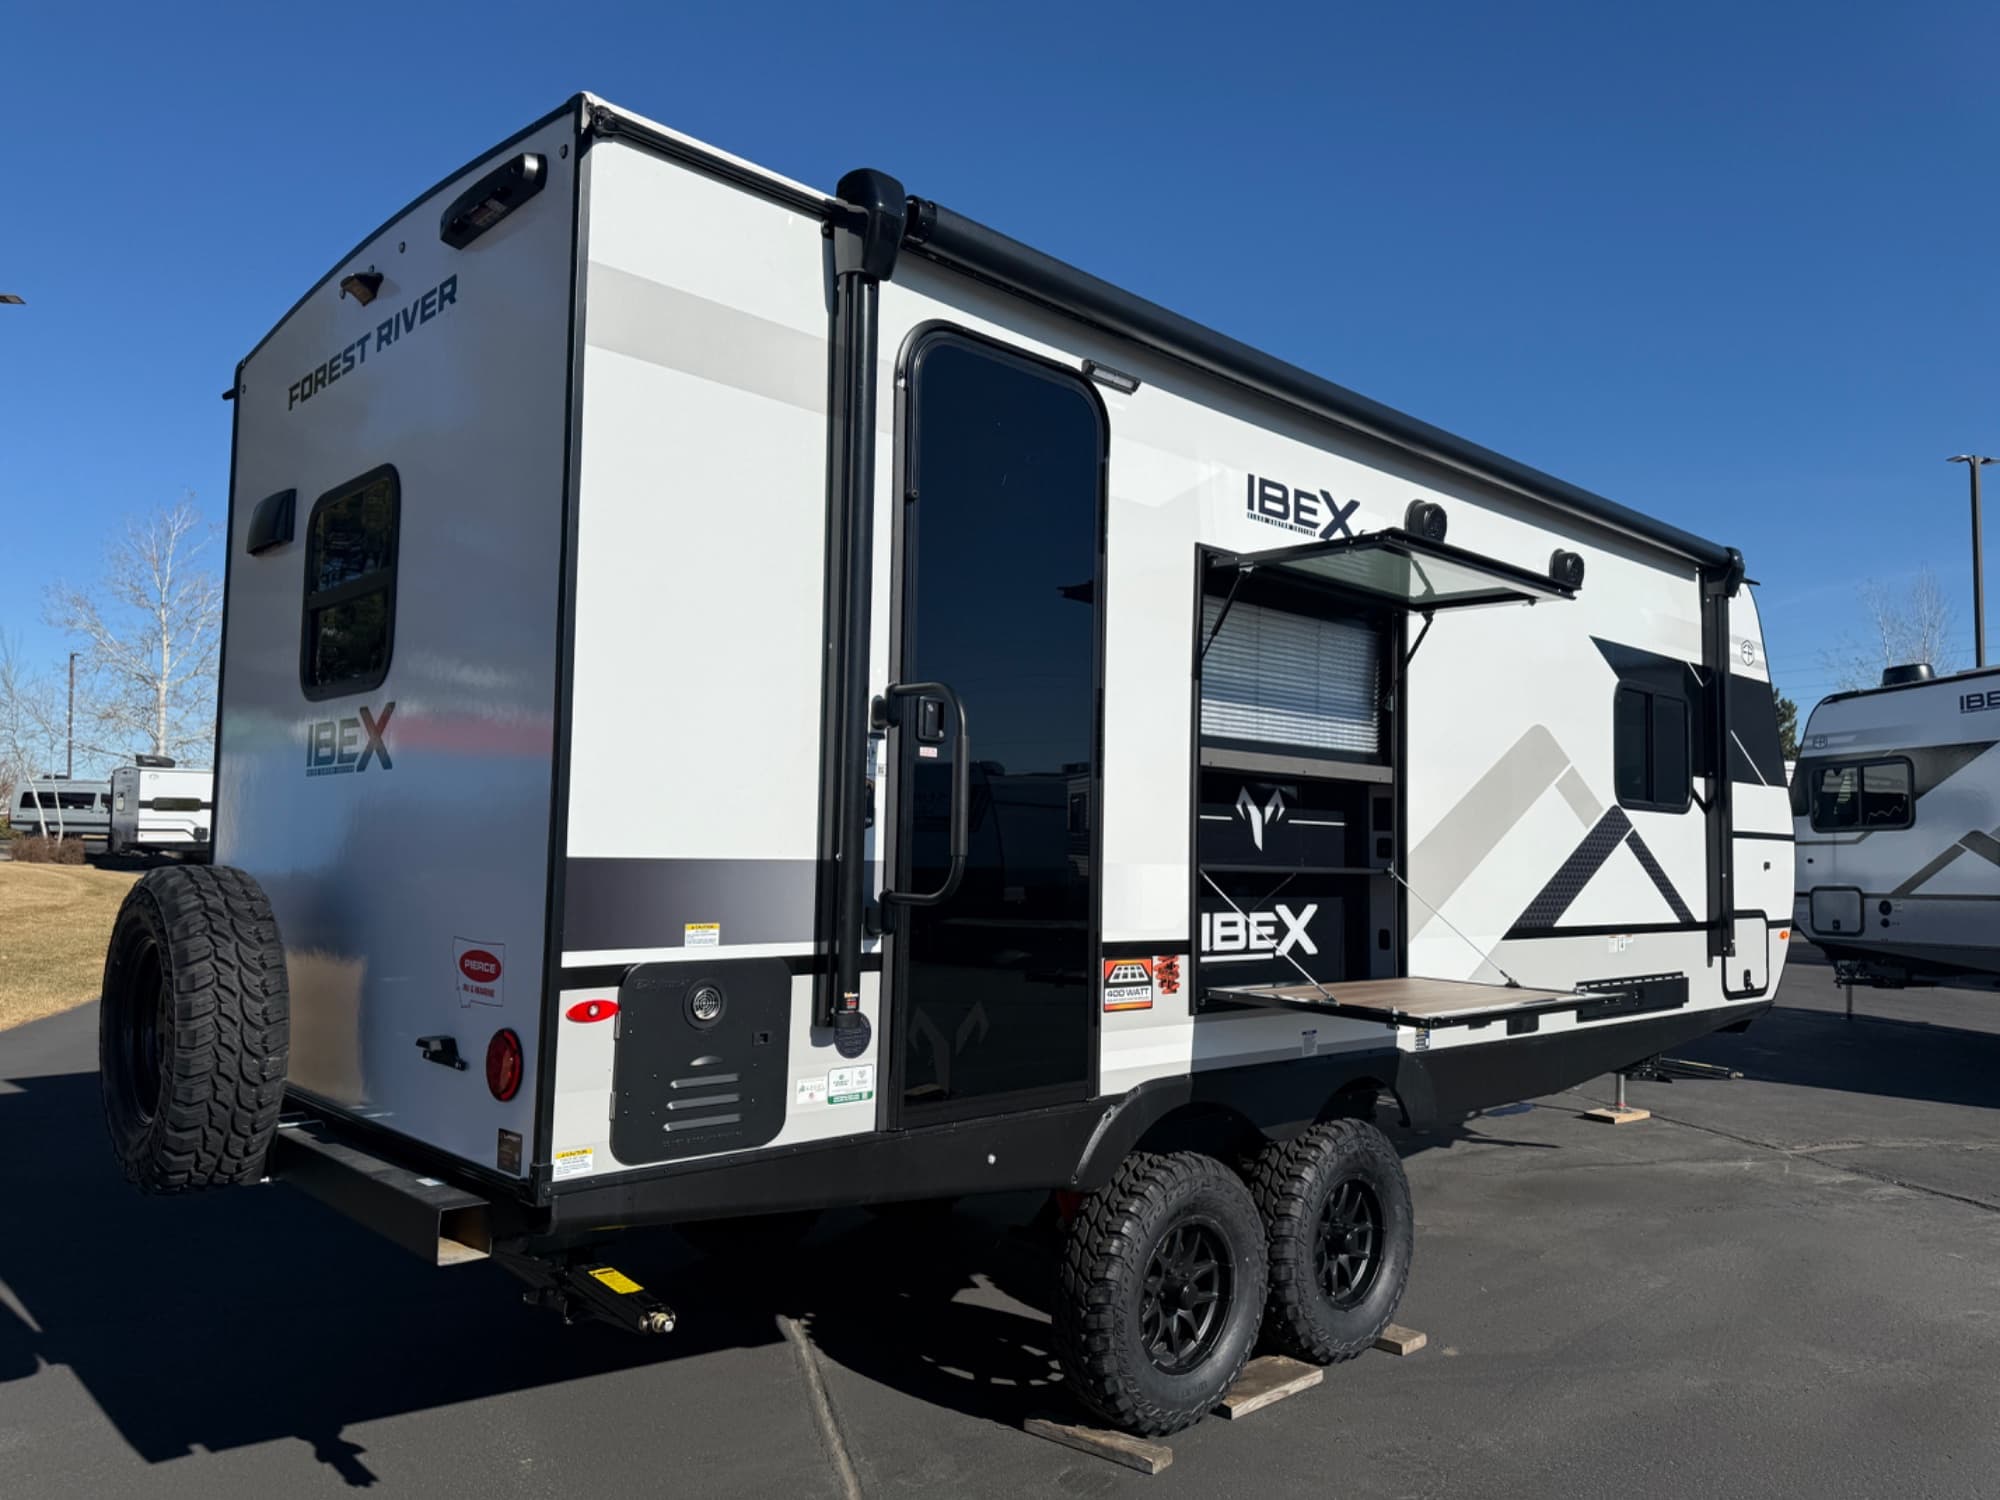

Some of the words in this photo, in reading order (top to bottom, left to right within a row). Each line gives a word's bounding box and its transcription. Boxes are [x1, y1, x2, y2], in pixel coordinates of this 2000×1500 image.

[287, 331, 372, 412] FOREST
[376, 273, 458, 353] RIVER
[1246, 472, 1361, 541] IBEX
[305, 701, 396, 774] IBEX
[1200, 903, 1319, 957] IBEX
[464, 958, 496, 974] PIERCE
[1106, 988, 1125, 998] 400
[1126, 987, 1150, 997] WATT
